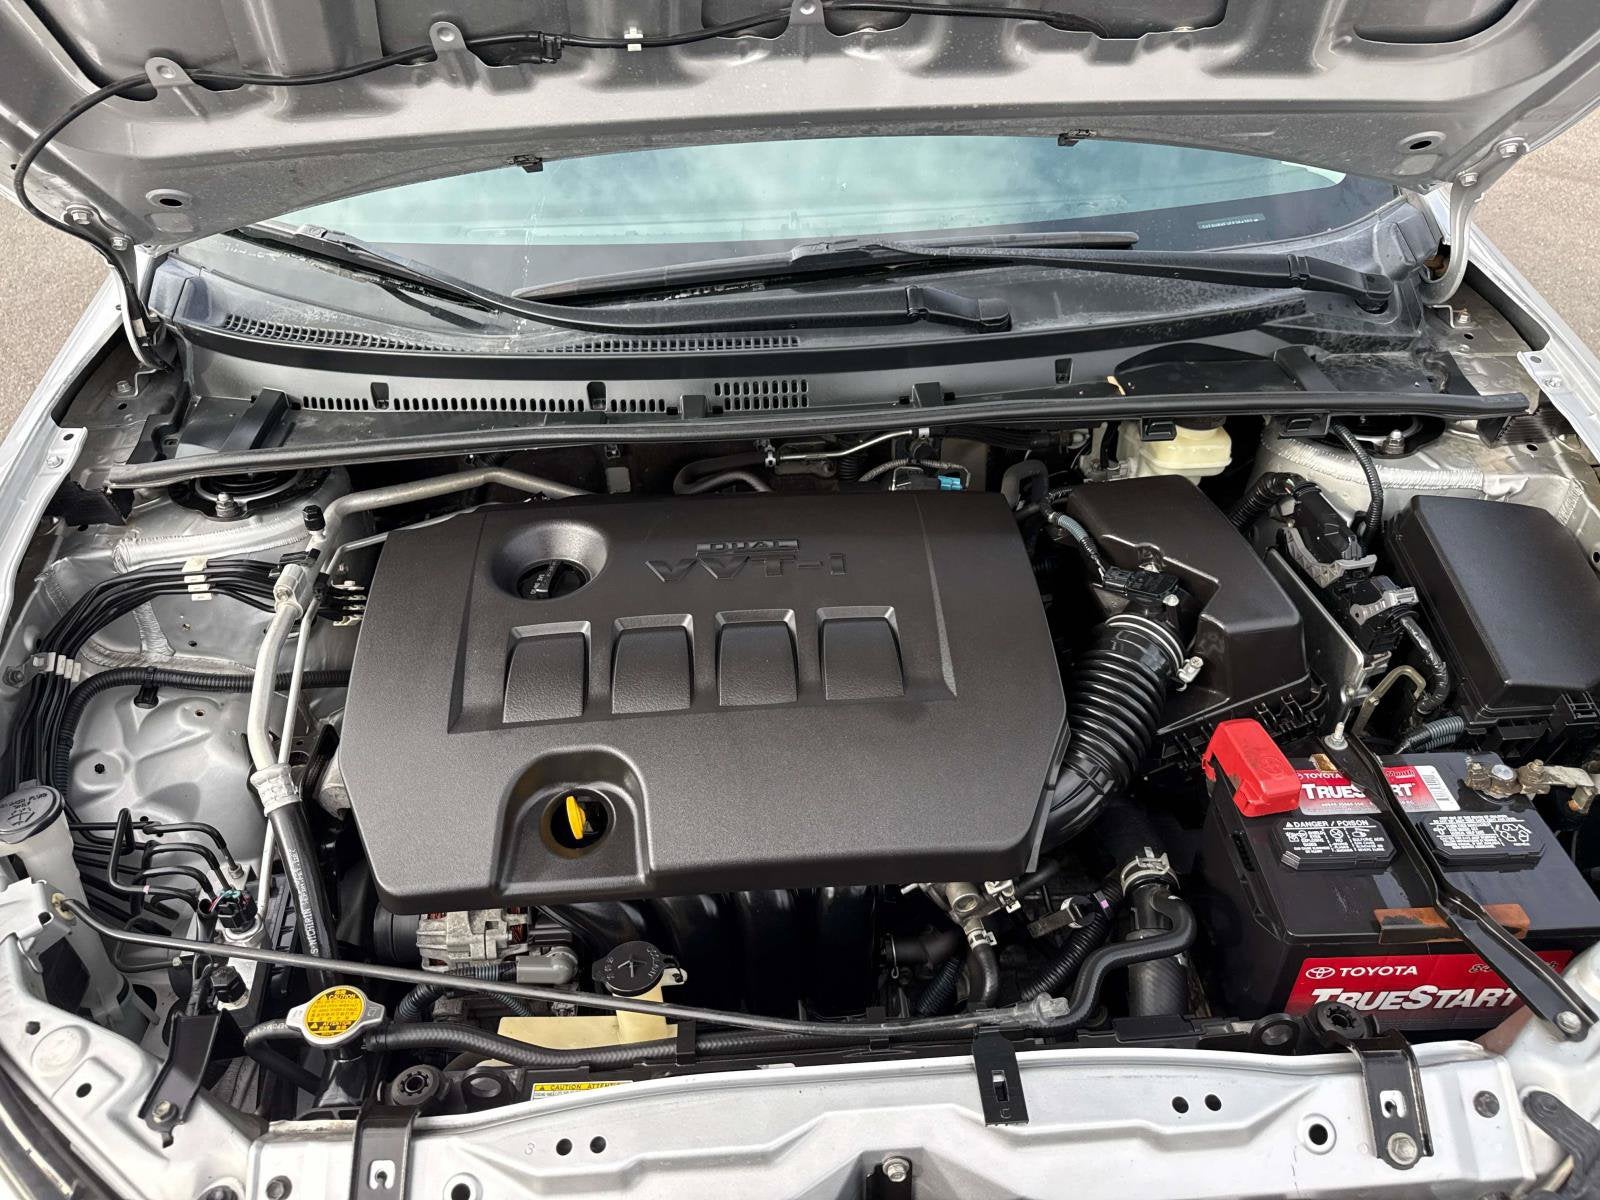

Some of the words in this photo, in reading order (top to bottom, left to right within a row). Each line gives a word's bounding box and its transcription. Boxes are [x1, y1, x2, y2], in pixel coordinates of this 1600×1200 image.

[710, 540, 799, 552] DUAL
[1336, 819, 1369, 827] POISON
[1339, 965, 1418, 977] TOYOTA
[550, 1083, 582, 1091] CAUTION
